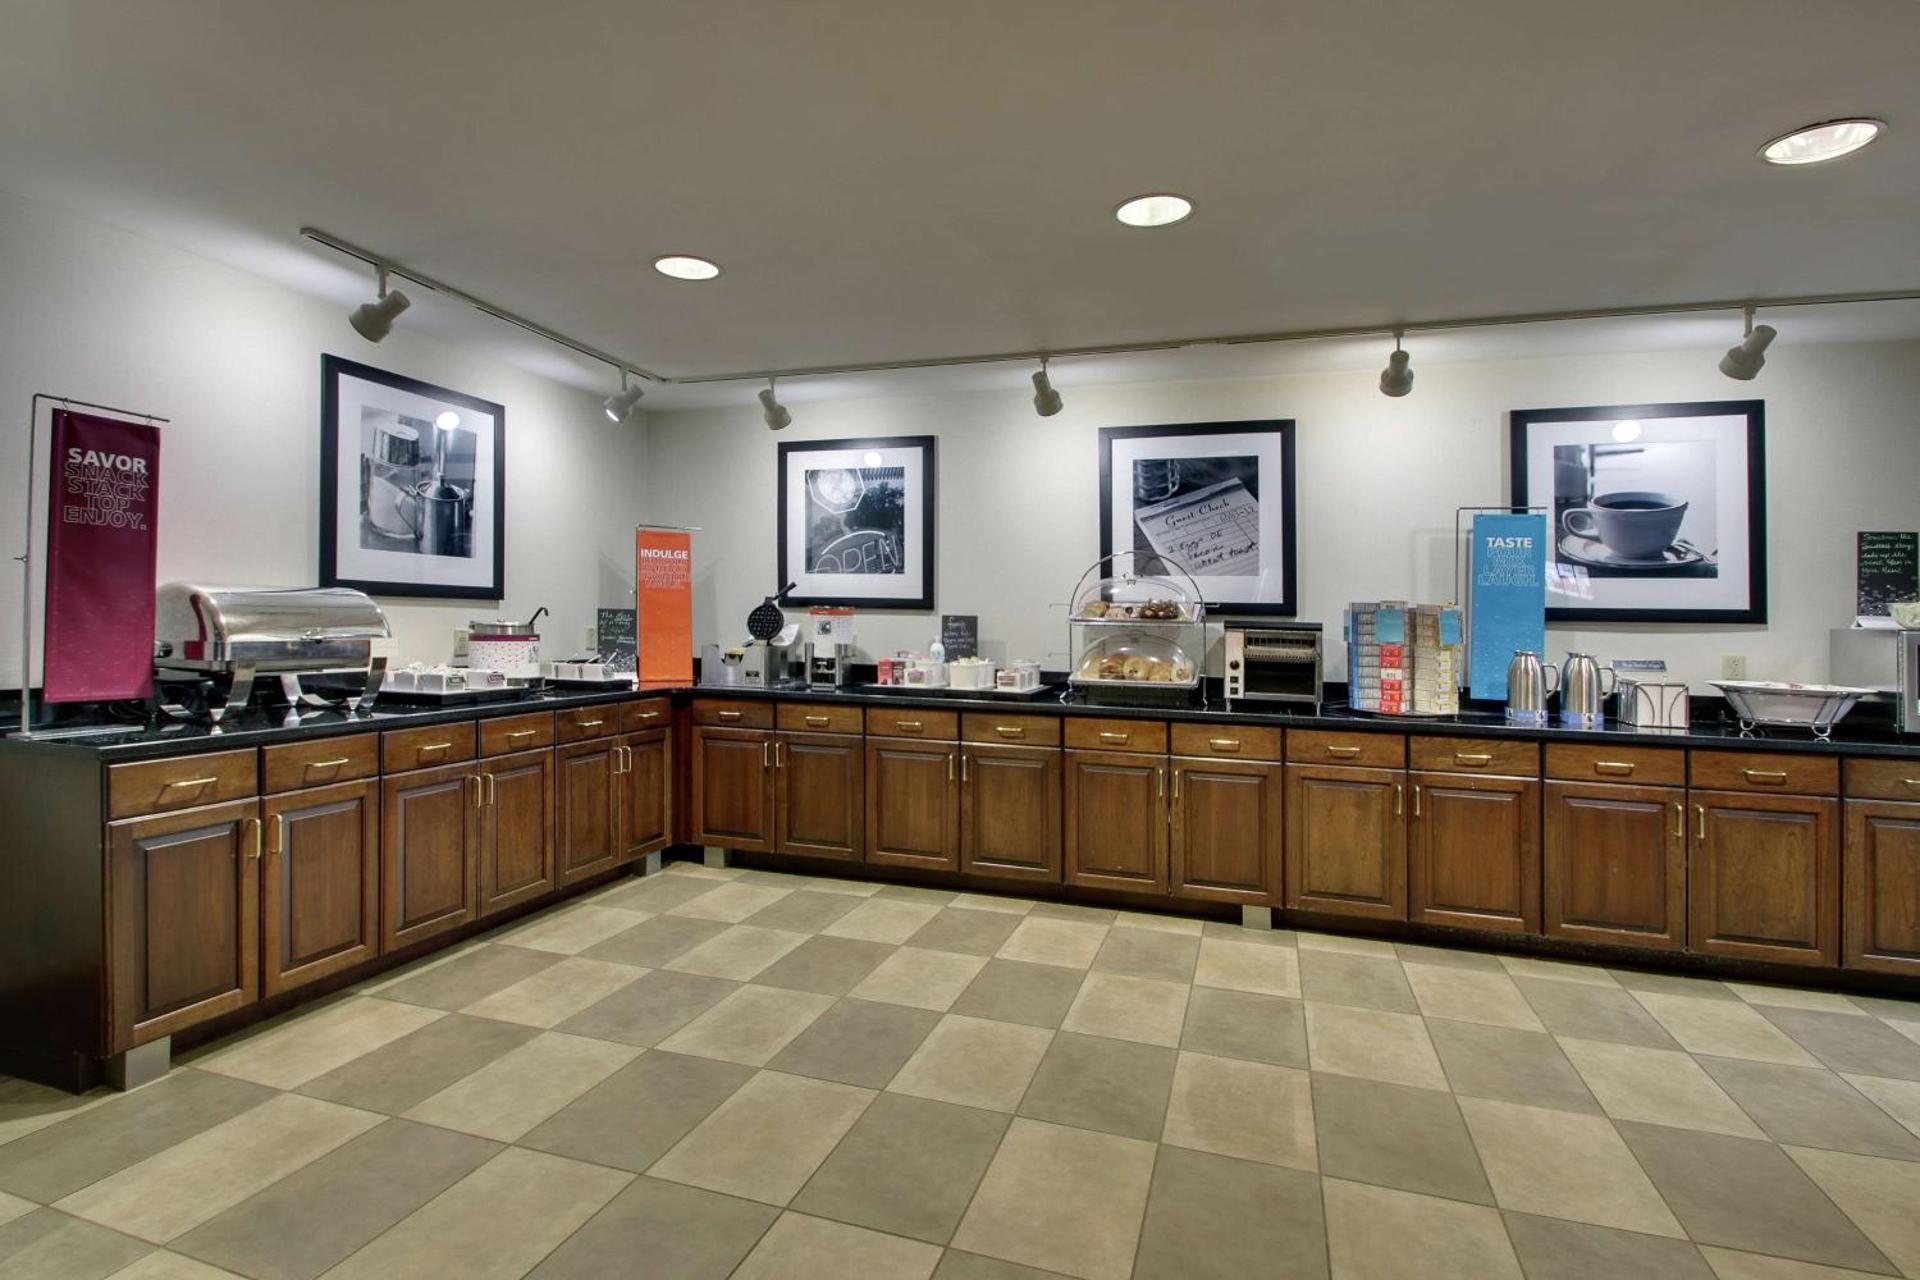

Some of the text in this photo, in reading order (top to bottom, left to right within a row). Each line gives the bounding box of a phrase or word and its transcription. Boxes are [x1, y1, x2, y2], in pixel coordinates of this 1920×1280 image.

[67, 447, 146, 473] SAVOR
[64, 462, 149, 488] SNACK
[67, 477, 146, 502] STACK
[84, 492, 131, 511] TOP
[63, 505, 148, 530] ENJOY.
[1165, 511, 1194, 526] Guest
[1199, 498, 1230, 515] Check
[640, 548, 689, 560] INDULGE
[1486, 536, 1533, 548] TASTE
